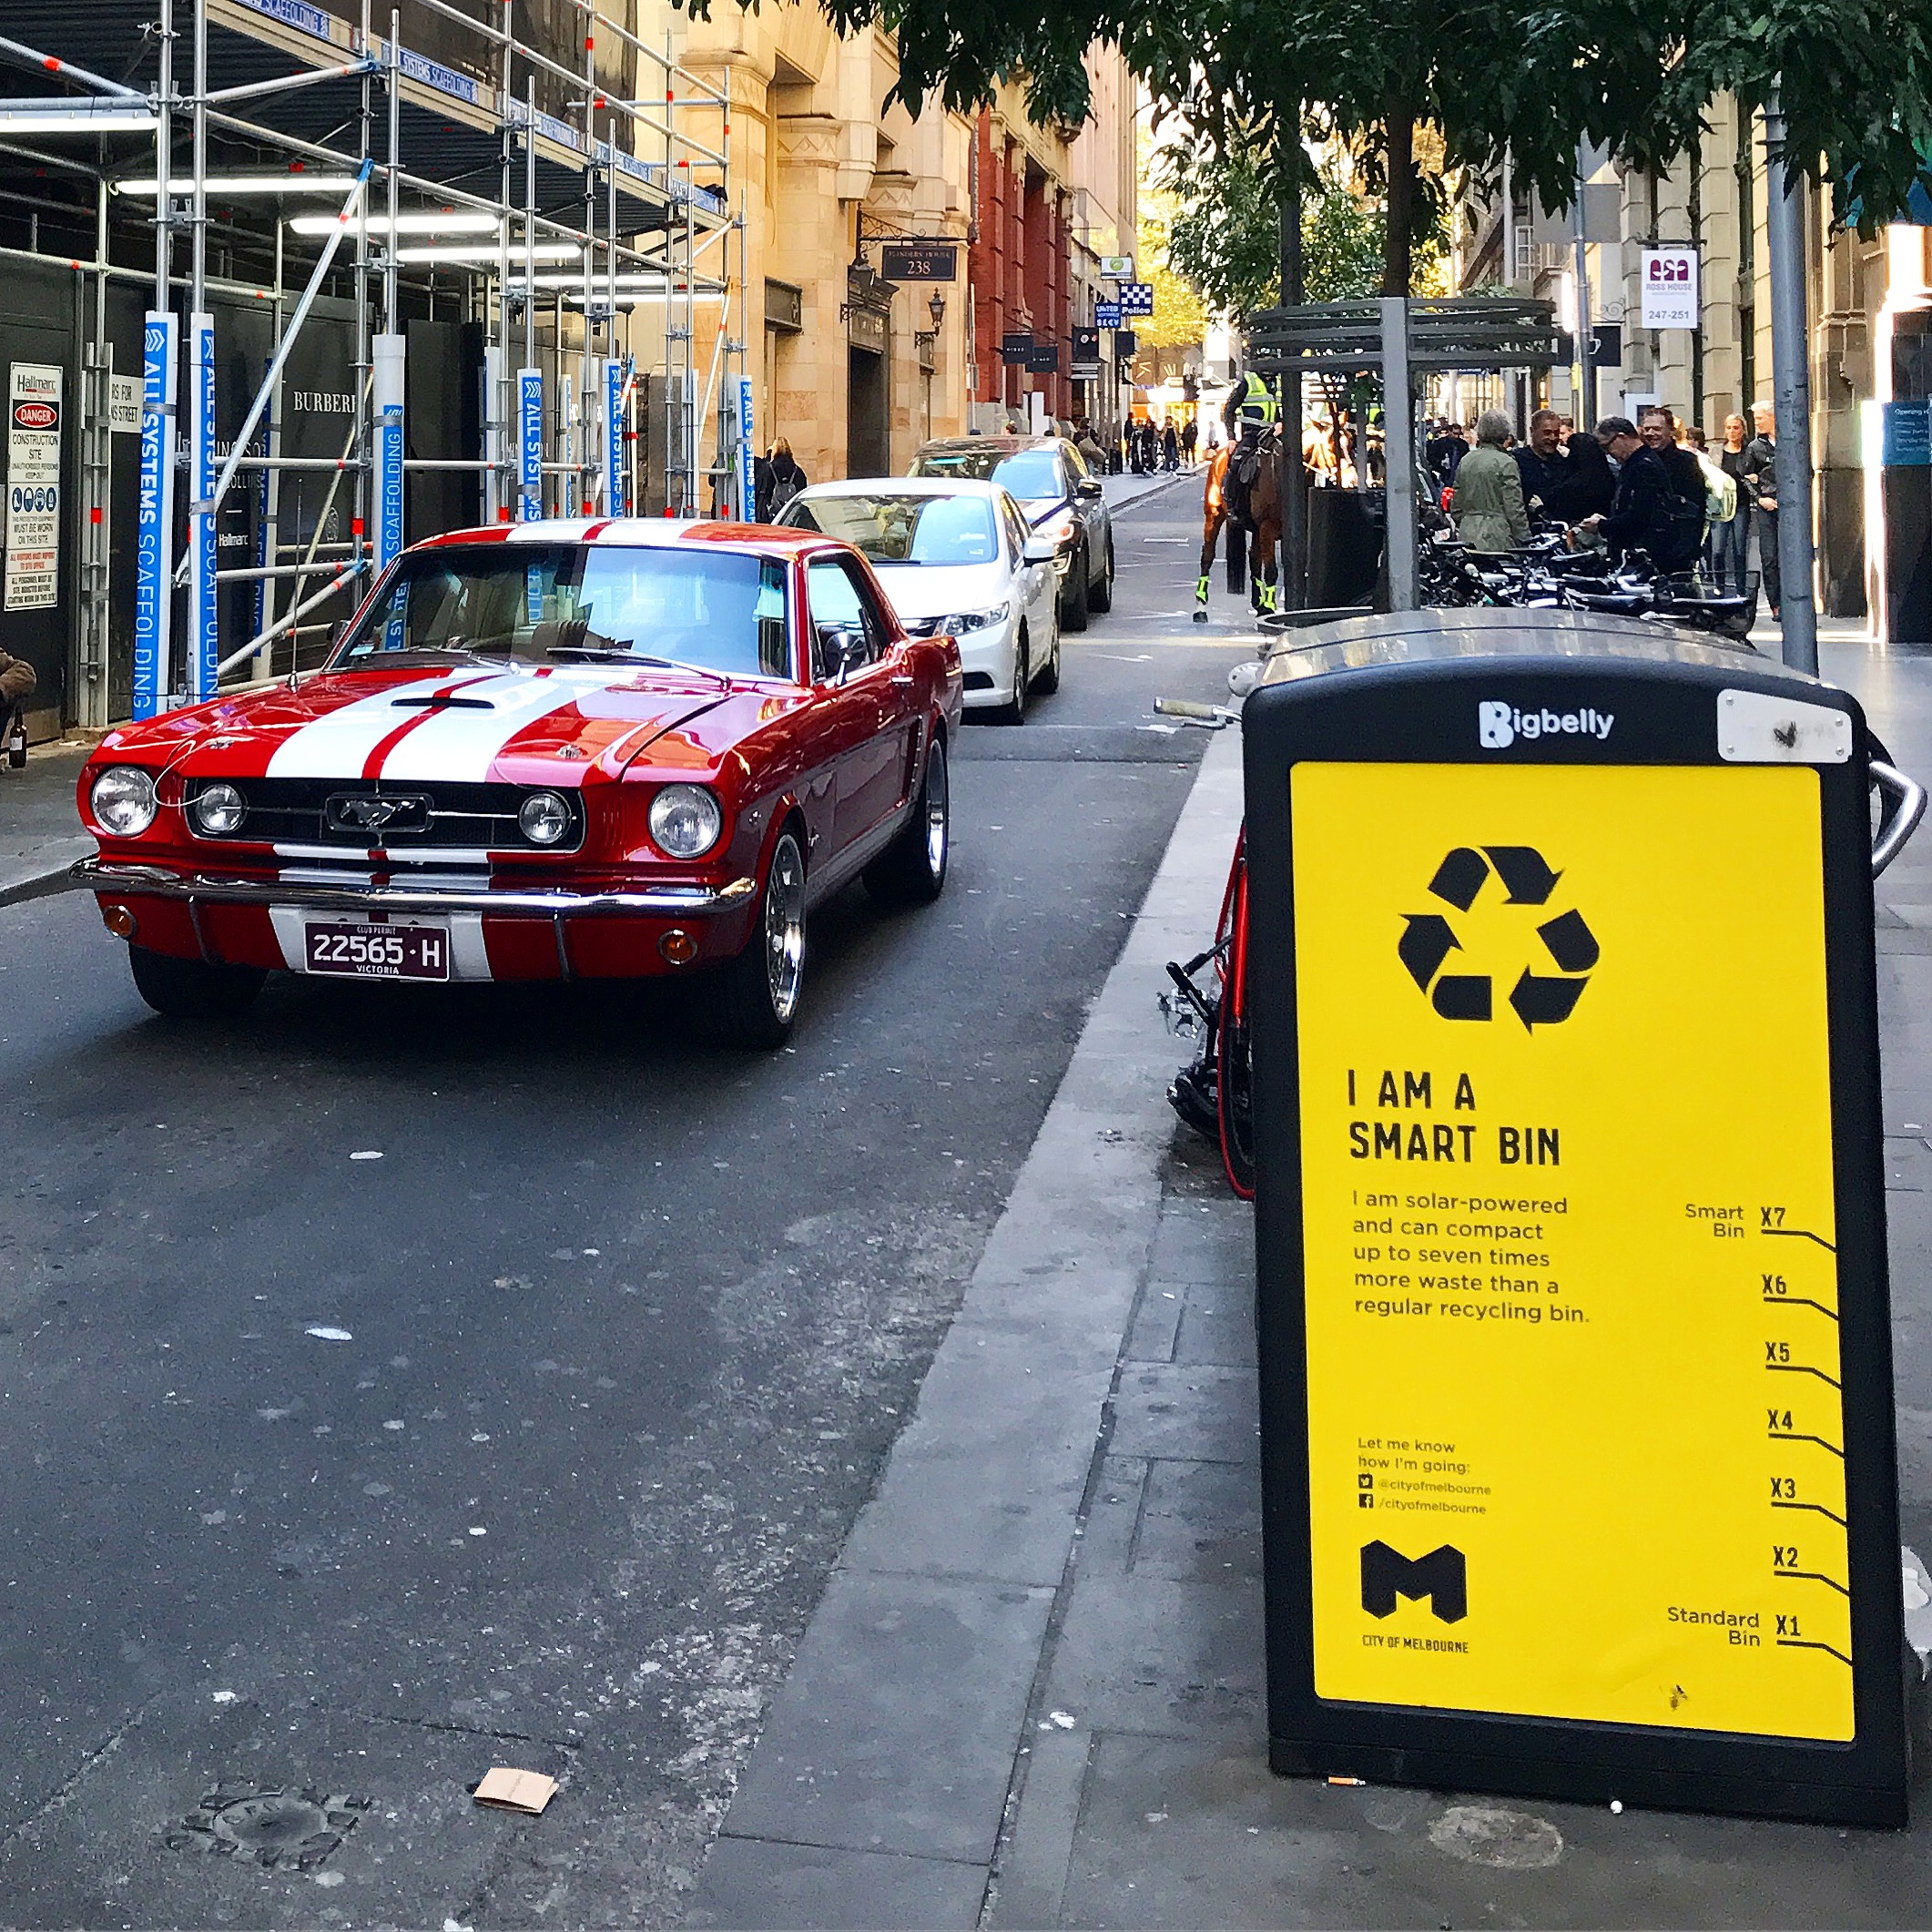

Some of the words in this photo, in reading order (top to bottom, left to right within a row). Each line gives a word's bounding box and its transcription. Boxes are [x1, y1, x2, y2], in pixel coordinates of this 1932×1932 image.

[907, 260, 931, 275] 238
[1667, 283, 1693, 291] HOUSE
[1121, 306, 1151, 314] Police
[1648, 310, 1690, 320] 247-251
[17, 374, 56, 392] Hallmarc
[143, 363, 161, 402] ALL
[20, 409, 52, 422] DANGER
[12, 434, 58, 446] CONSTRUCTION
[28, 449, 42, 460] SITE
[139, 412, 159, 525] SYSTEMS
[386, 432, 402, 552] SCAFFOLDING
[133, 534, 156, 708] SCAFFOLDING
[1478, 700, 1615, 748] Bigbelly
[356, 925, 373, 934] CLUB
[356, 964, 400, 975] VICTORIA
[1347, 1069, 1357, 1107] I
[1378, 1069, 1432, 1110] AM
[1453, 1072, 1477, 1112] A
[1347, 1122, 1476, 1164] SMART
[1500, 1127, 1561, 1166] BIN
[1353, 1190, 1358, 1206] I
[1366, 1194, 1398, 1207] am
[1405, 1192, 1568, 1215] solar-powered
[1684, 1203, 1745, 1221] Smart
[1760, 1205, 1786, 1227] X7
[1353, 1216, 1393, 1235] and
[1400, 1221, 1439, 1235] can
[1446, 1223, 1543, 1242] compact
[1713, 1222, 1745, 1239] Bin
[1354, 1246, 1381, 1263] up
[1388, 1245, 1411, 1262] to
[1418, 1249, 1482, 1265] seven
[1489, 1247, 1551, 1267] times
[1354, 1273, 1411, 1288] more
[1418, 1274, 1482, 1291] waste
[1490, 1275, 1539, 1294] than
[1547, 1281, 1559, 1295] a
[1762, 1273, 1787, 1296] X6
[1355, 1296, 1433, 1317] regular
[1440, 1301, 1541, 1324] recycling
[1550, 1304, 1591, 1324] bin.
[1764, 1340, 1790, 1363] X5
[1766, 1408, 1794, 1430] X4
[1357, 1438, 1382, 1449] Let
[1387, 1440, 1410, 1450] me
[1415, 1439, 1456, 1453] know
[1357, 1455, 1390, 1469] how
[1395, 1457, 1418, 1470] I'm
[1422, 1460, 1471, 1476] going:
[1378, 1479, 1492, 1496] @cityofmelbourne
[1770, 1476, 1796, 1500] X3
[1378, 1498, 1487, 1515] /cityofmelbourne
[1772, 1545, 1798, 1569] X2
[1667, 1606, 1760, 1628] Standard
[1774, 1613, 1802, 1637] X1
[1362, 1634, 1385, 1647] CITY
[1387, 1636, 1400, 1649] OF
[1403, 1637, 1469, 1654] MELBOURNE
[1728, 1629, 1761, 1647] Bin
